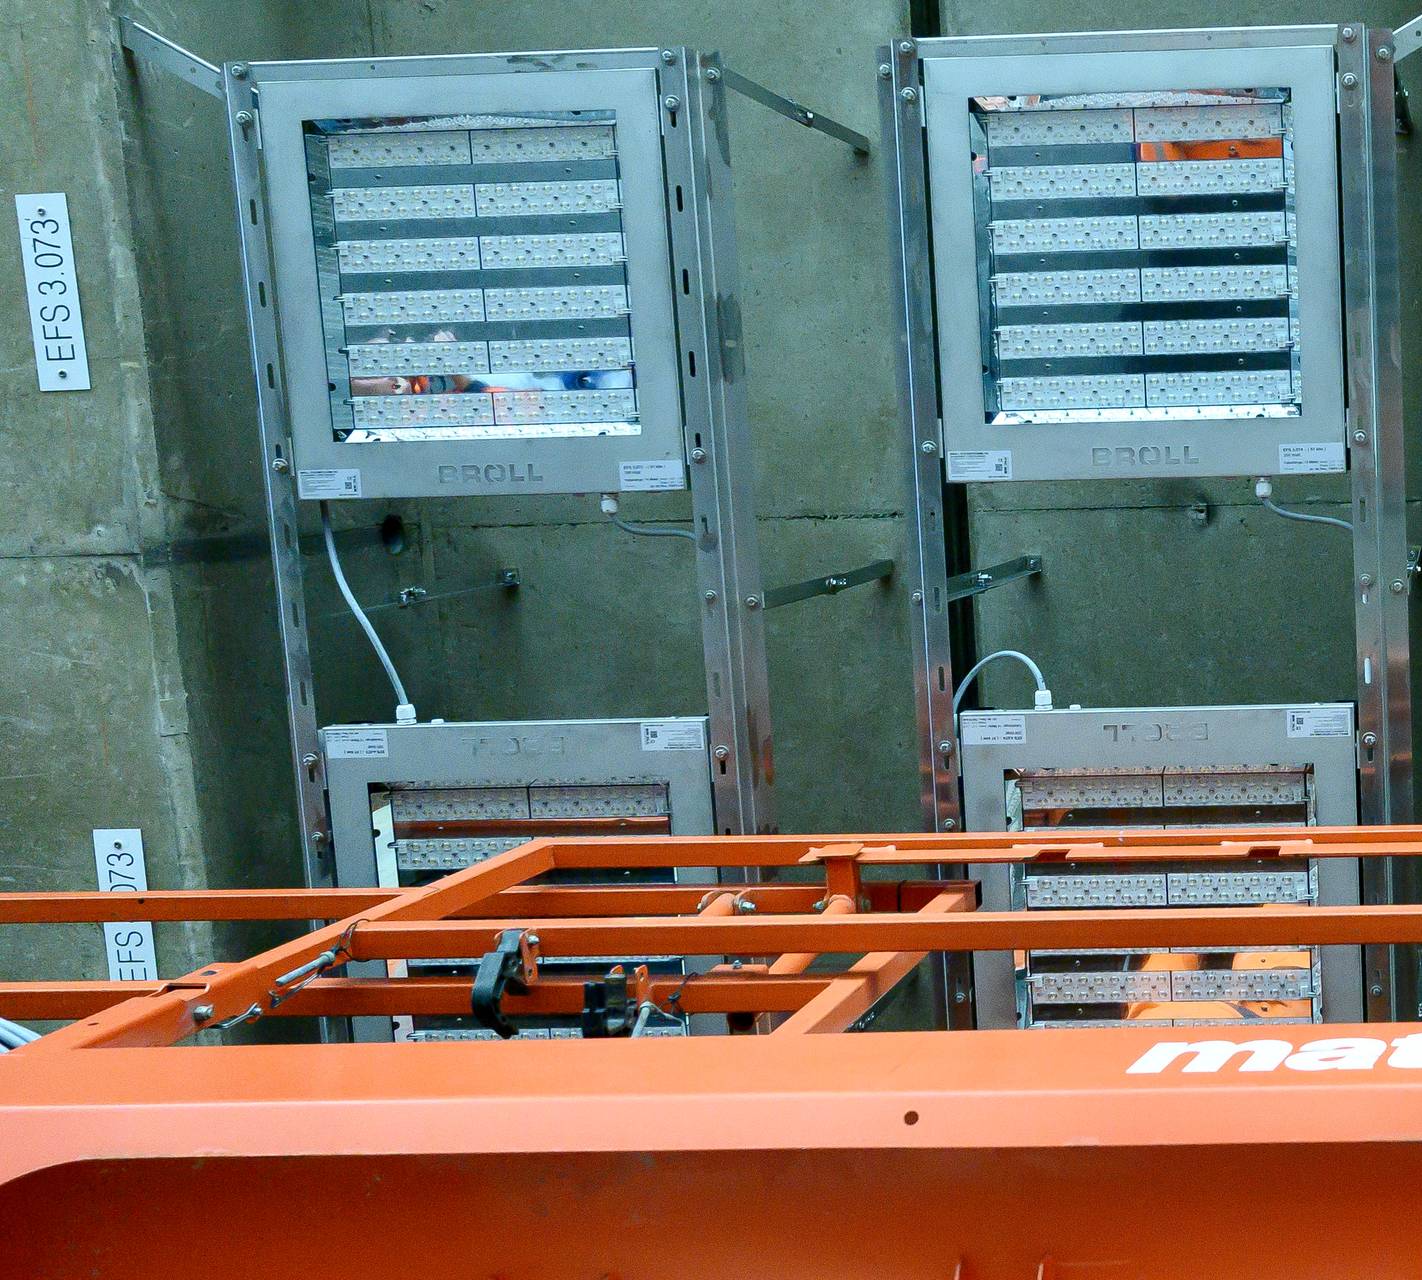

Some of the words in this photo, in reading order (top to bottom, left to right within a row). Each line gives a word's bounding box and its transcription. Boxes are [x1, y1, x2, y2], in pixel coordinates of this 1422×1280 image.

[30, 218, 67, 296] 3.073
[39, 304, 76, 361] EFS
[438, 463, 544, 484] BROLL
[1091, 445, 1200, 467] BROLL
